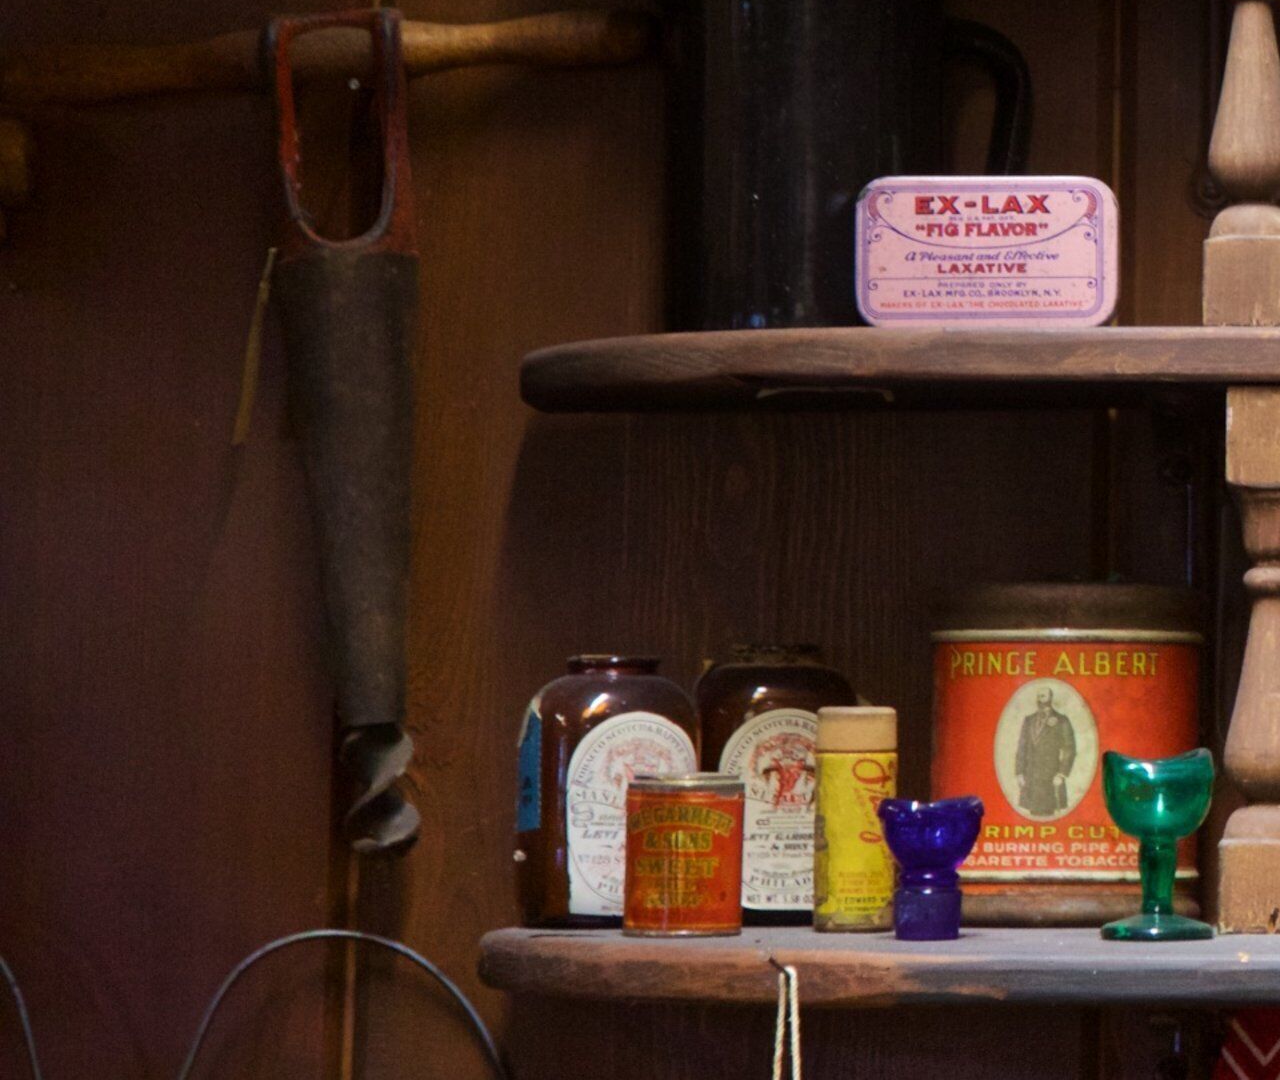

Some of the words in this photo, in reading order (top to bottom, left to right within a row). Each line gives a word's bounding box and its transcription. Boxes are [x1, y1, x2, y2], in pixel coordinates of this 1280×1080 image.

[914, 194, 1051, 216] EX-LAX
[905, 251, 917, 262] A
[919, 250, 975, 262] Pleasant
[976, 250, 1001, 261] and
[1003, 249, 1060, 262] Effective
[937, 263, 1028, 275] LAXATIVE
[937, 281, 985, 289] PREPARED
[988, 281, 1013, 289] ONLY
[903, 290, 942, 298] EX-LAX
[951, 651, 1037, 678] PRINCE
[1053, 651, 1159, 677] ALBERT
[727, 734, 753, 774] OBACCO
[582, 829, 619, 839] LEVI
[984, 825, 1057, 840] RIMP
[1067, 825, 1121, 840] CUT
[983, 842, 1064, 854] BURNING
[1071, 842, 1109, 854] PIPE
[1115, 842, 1139, 854] AN
[963, 855, 1049, 867] GARETTE
